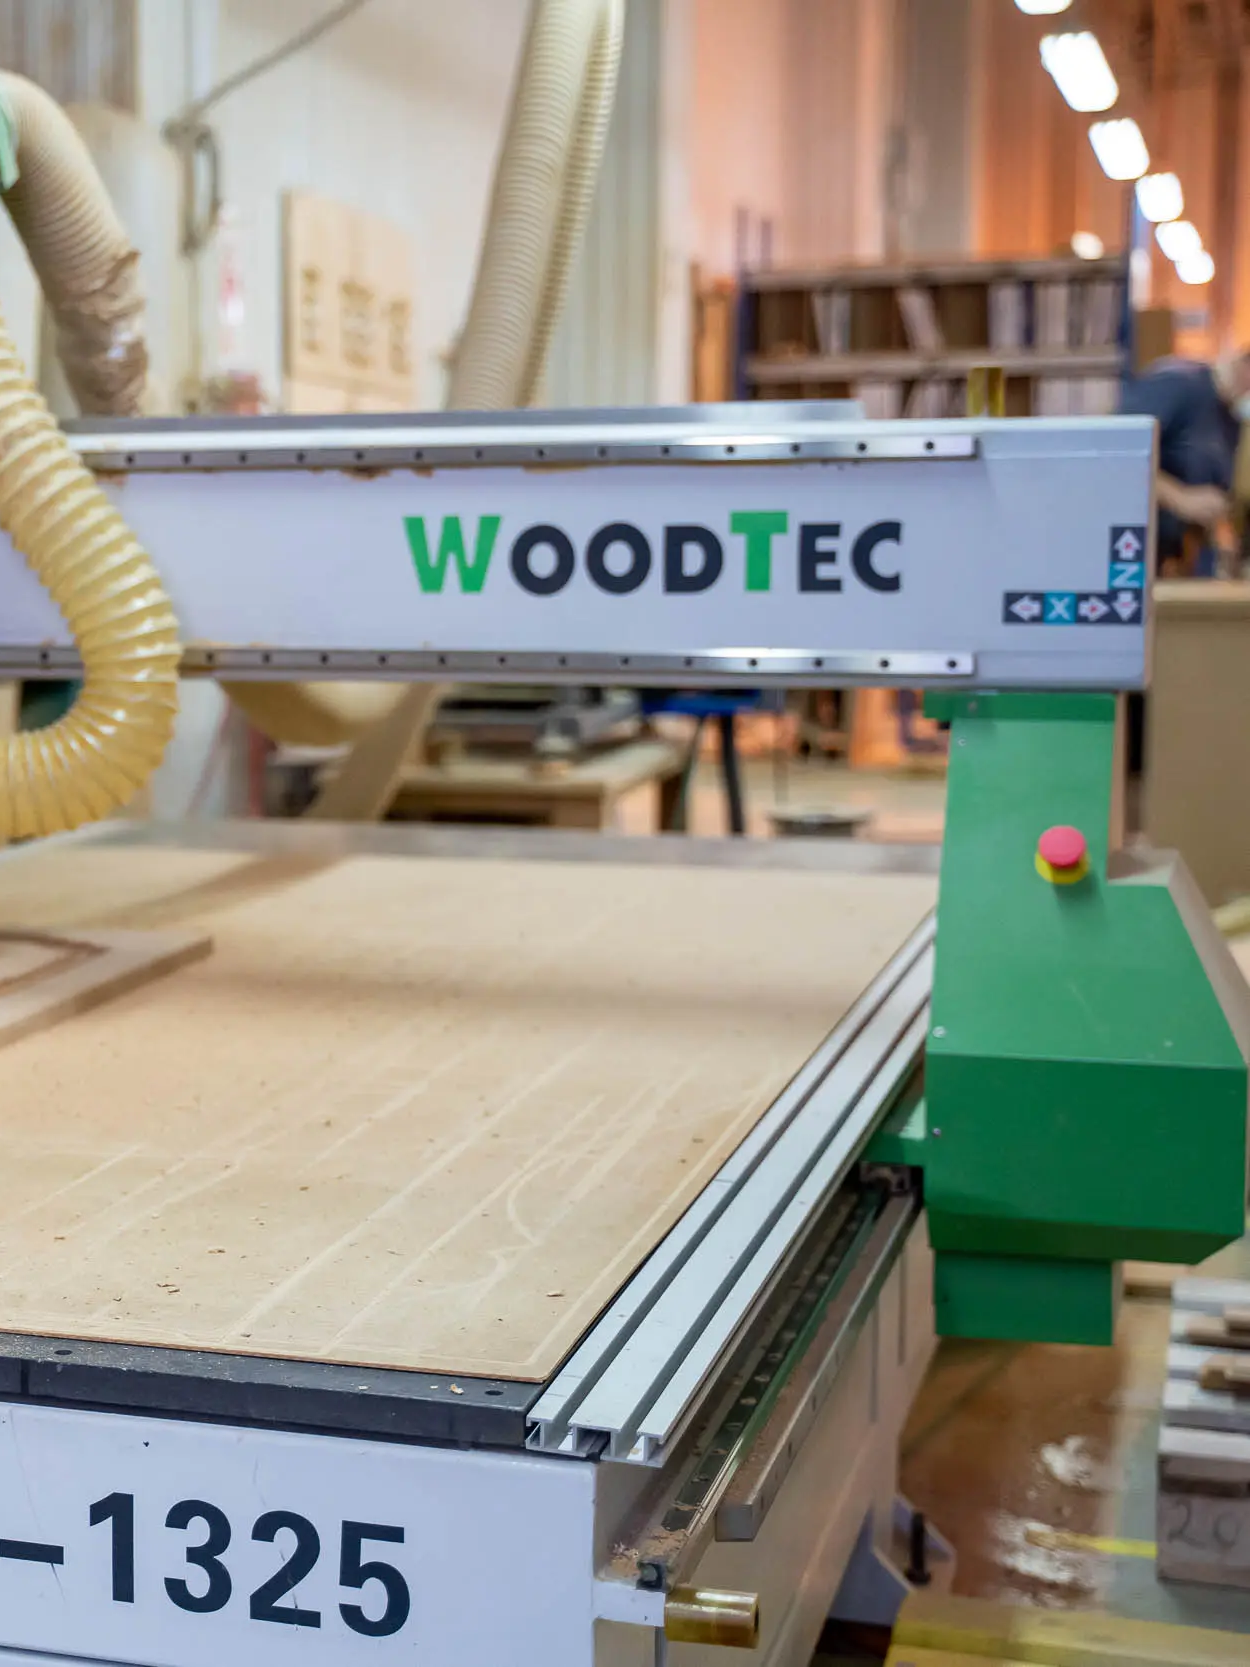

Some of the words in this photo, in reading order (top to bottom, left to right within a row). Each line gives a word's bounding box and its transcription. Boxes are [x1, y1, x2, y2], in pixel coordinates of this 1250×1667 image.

[402, 510, 903, 597] WOODTEC
[1111, 562, 1142, 588] Z
[1046, 596, 1071, 621] X
